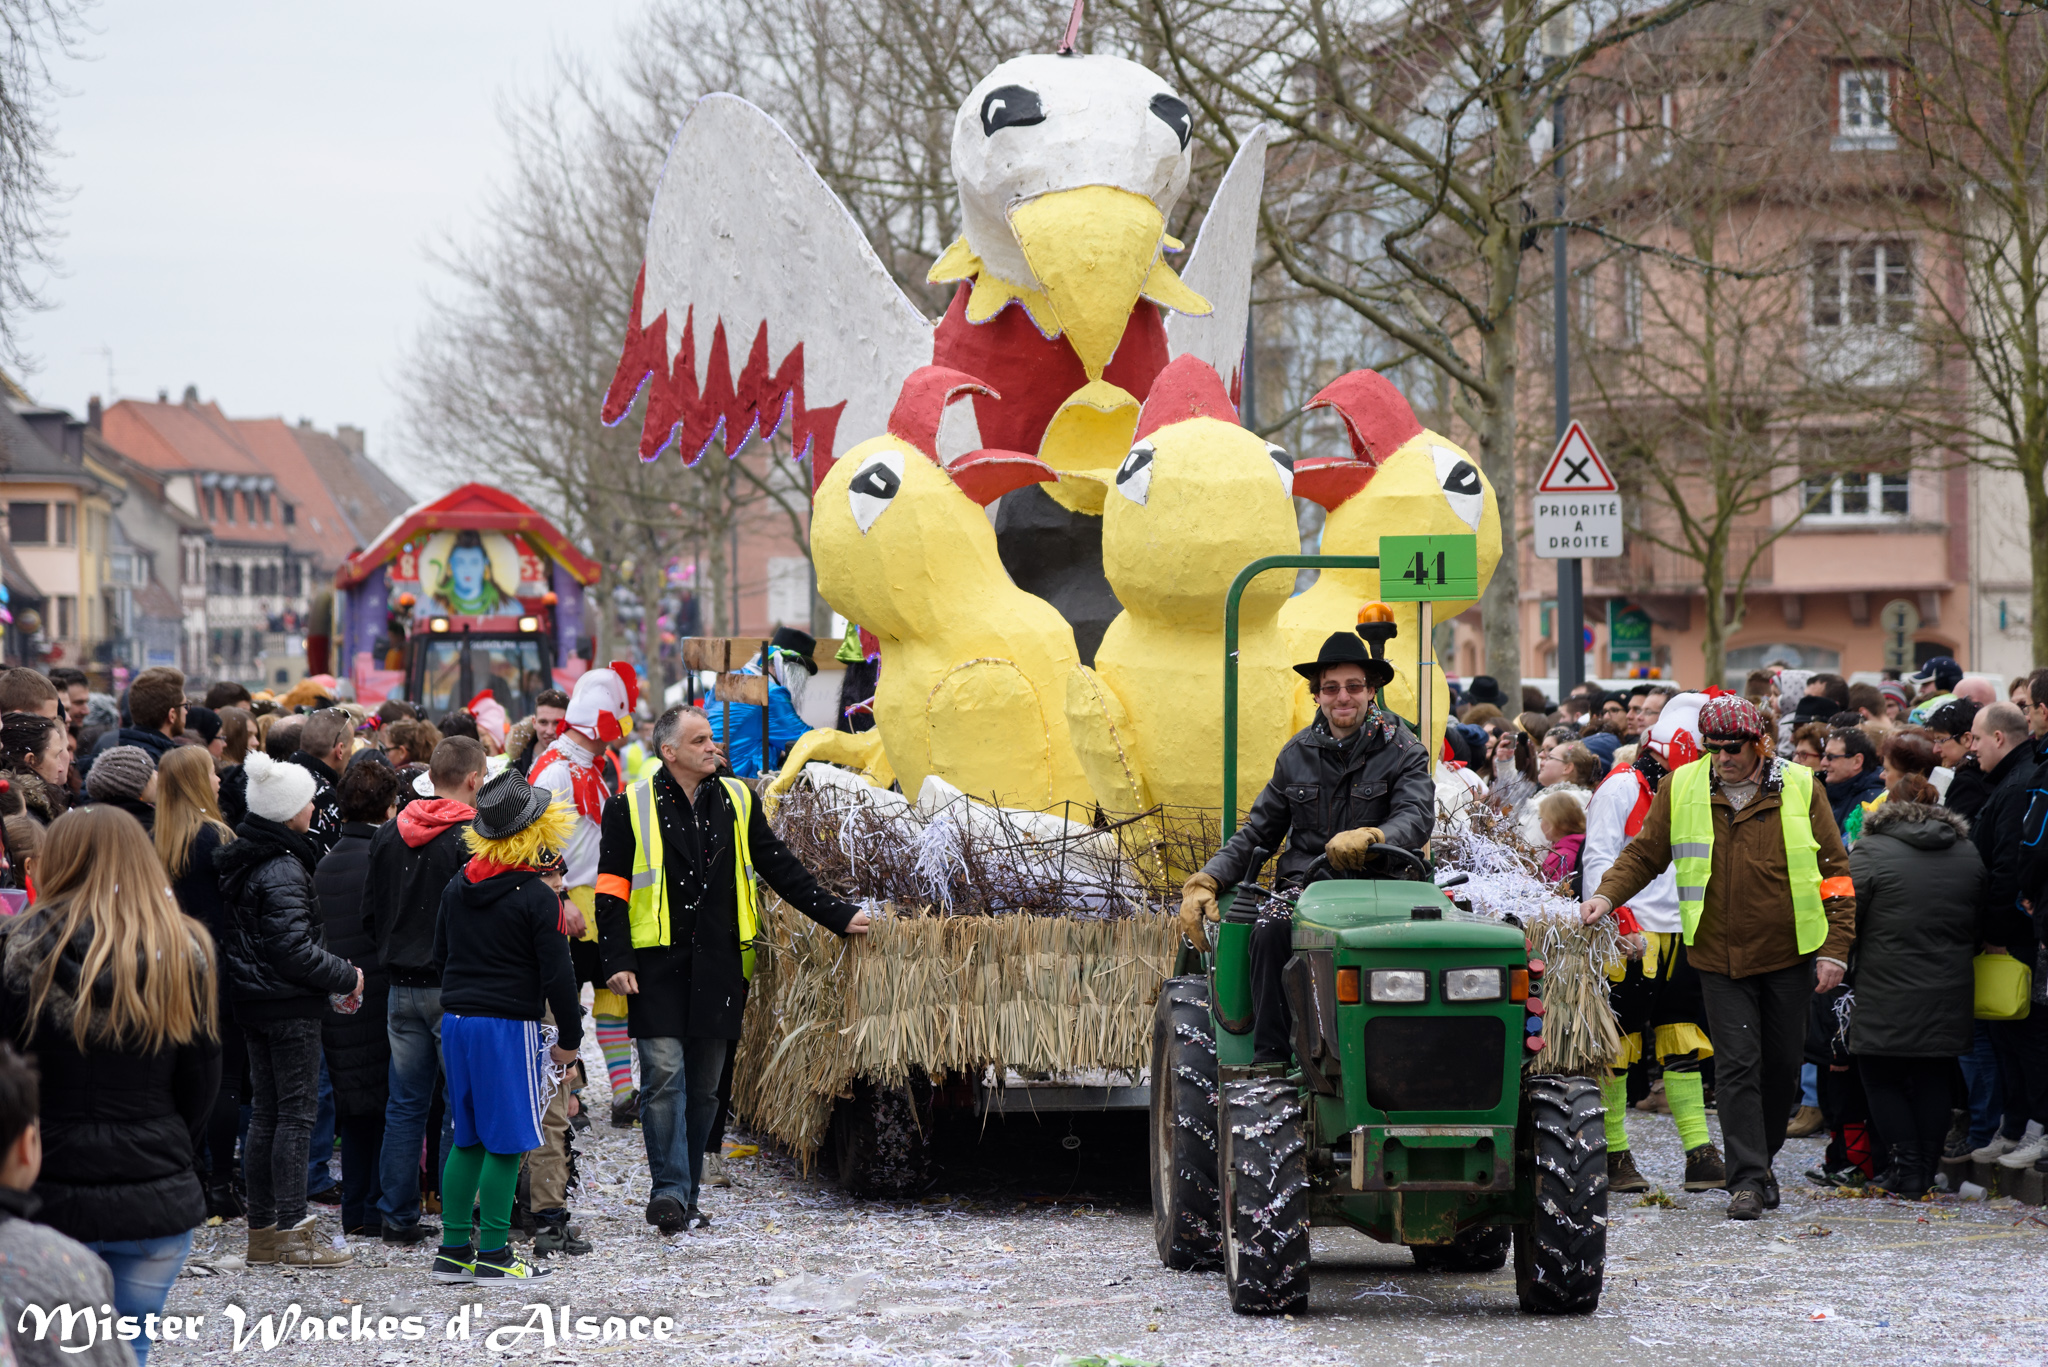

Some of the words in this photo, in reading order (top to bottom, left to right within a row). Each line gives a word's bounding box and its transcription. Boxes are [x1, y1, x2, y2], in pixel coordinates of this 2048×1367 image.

[1540, 502, 1617, 516] PRIORITÉ
[1575, 520, 1583, 532] A
[1550, 536, 1609, 548] DROITE
[1402, 551, 1448, 585] 41
